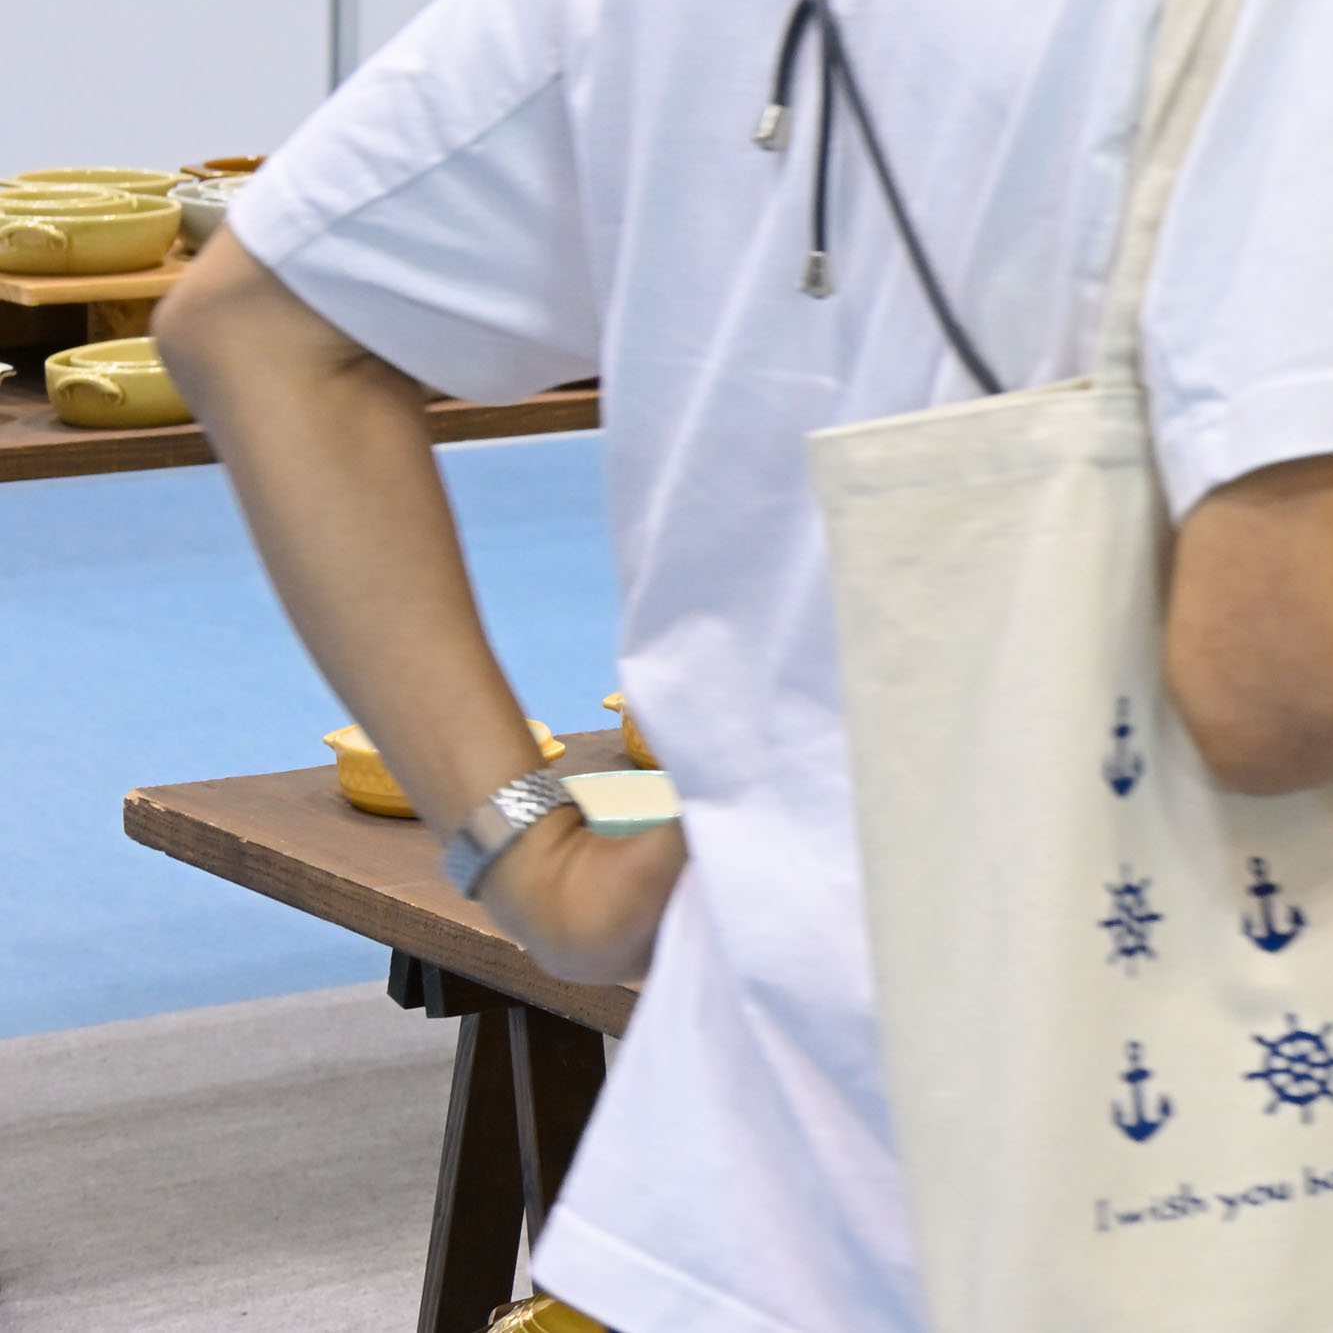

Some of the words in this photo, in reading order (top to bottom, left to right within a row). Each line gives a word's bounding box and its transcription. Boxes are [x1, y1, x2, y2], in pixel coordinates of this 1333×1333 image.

[1094, 1198, 1111, 1232] I
[1115, 1182, 1209, 1226] wish
[1213, 1180, 1295, 1222] you
